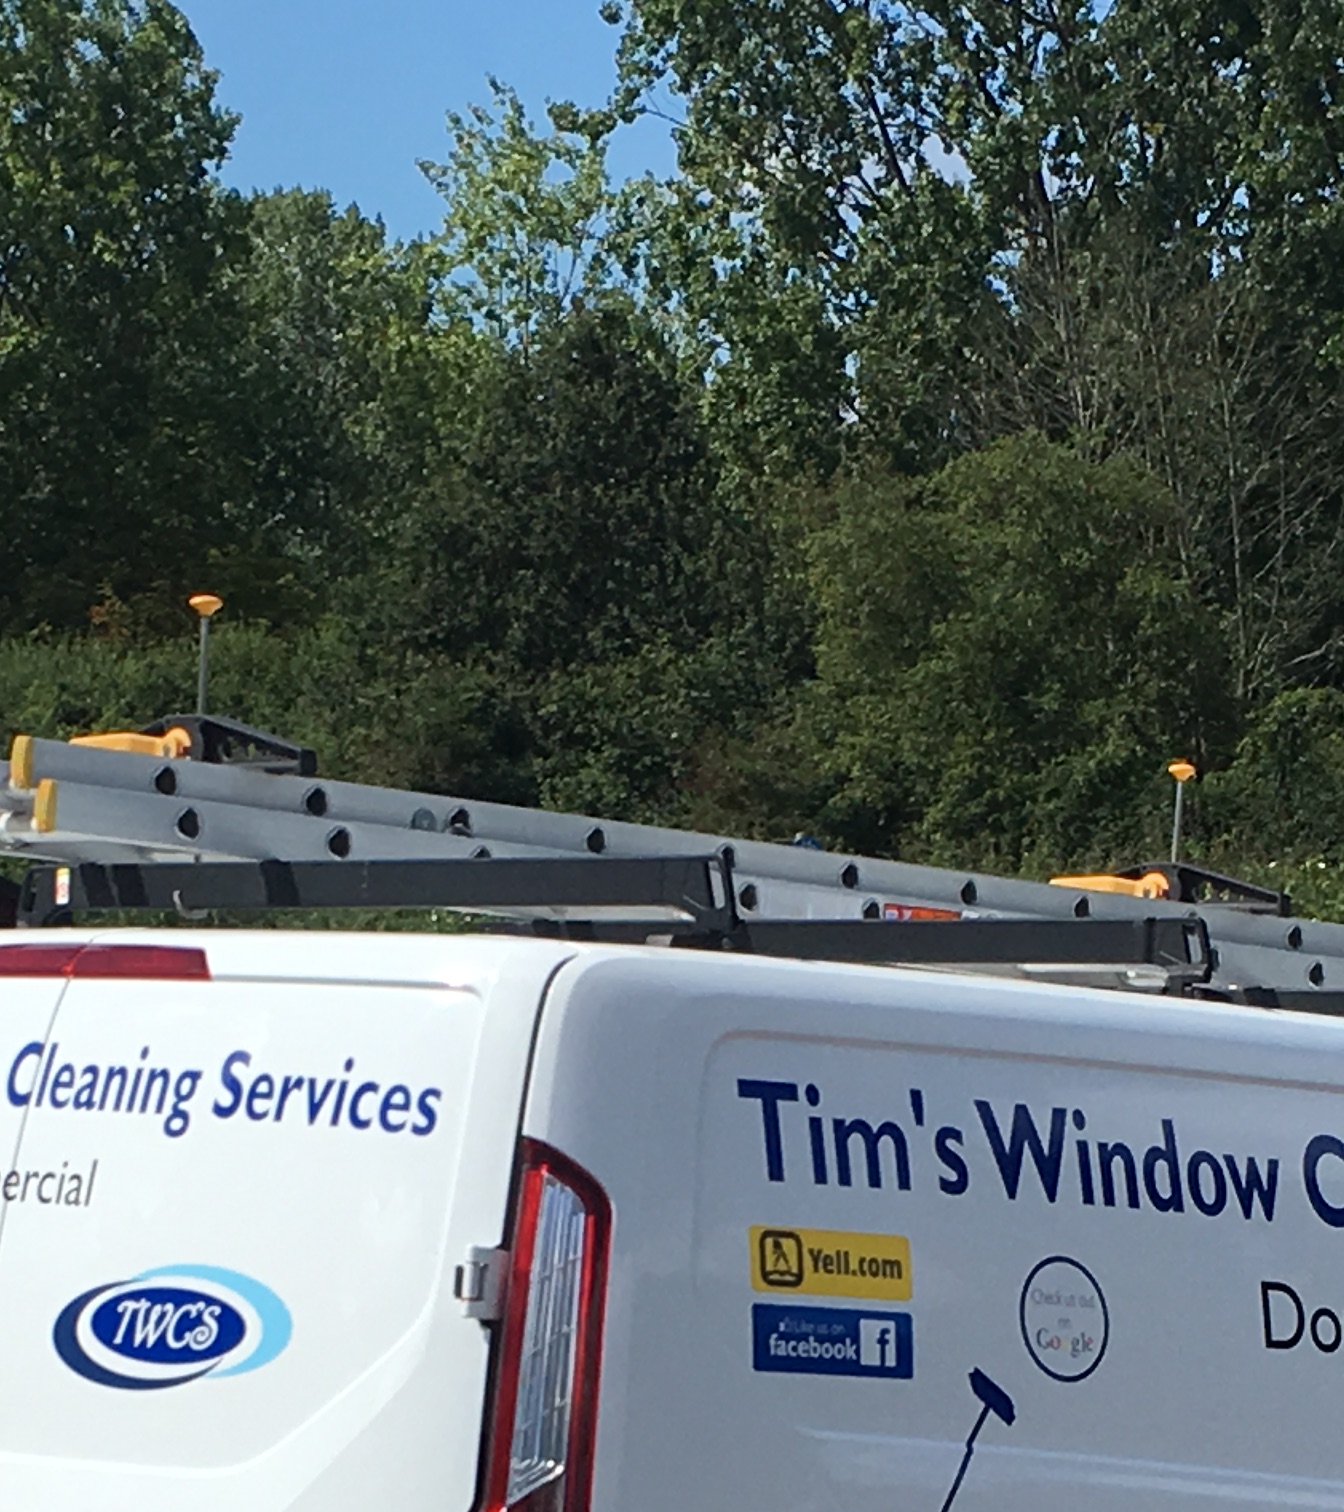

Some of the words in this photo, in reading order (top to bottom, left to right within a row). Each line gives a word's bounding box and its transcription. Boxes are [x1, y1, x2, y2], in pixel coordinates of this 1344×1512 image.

[6, 1041, 204, 1138] Cleaning
[212, 1049, 443, 1137] Services
[737, 1078, 970, 1196] Tim's
[973, 1098, 1280, 1223] Window
[807, 1248, 903, 1280] Yell.com
[112, 1298, 222, 1351] TWCS
[1036, 1327, 1094, 1358] Google
[769, 1333, 858, 1361] facebook
